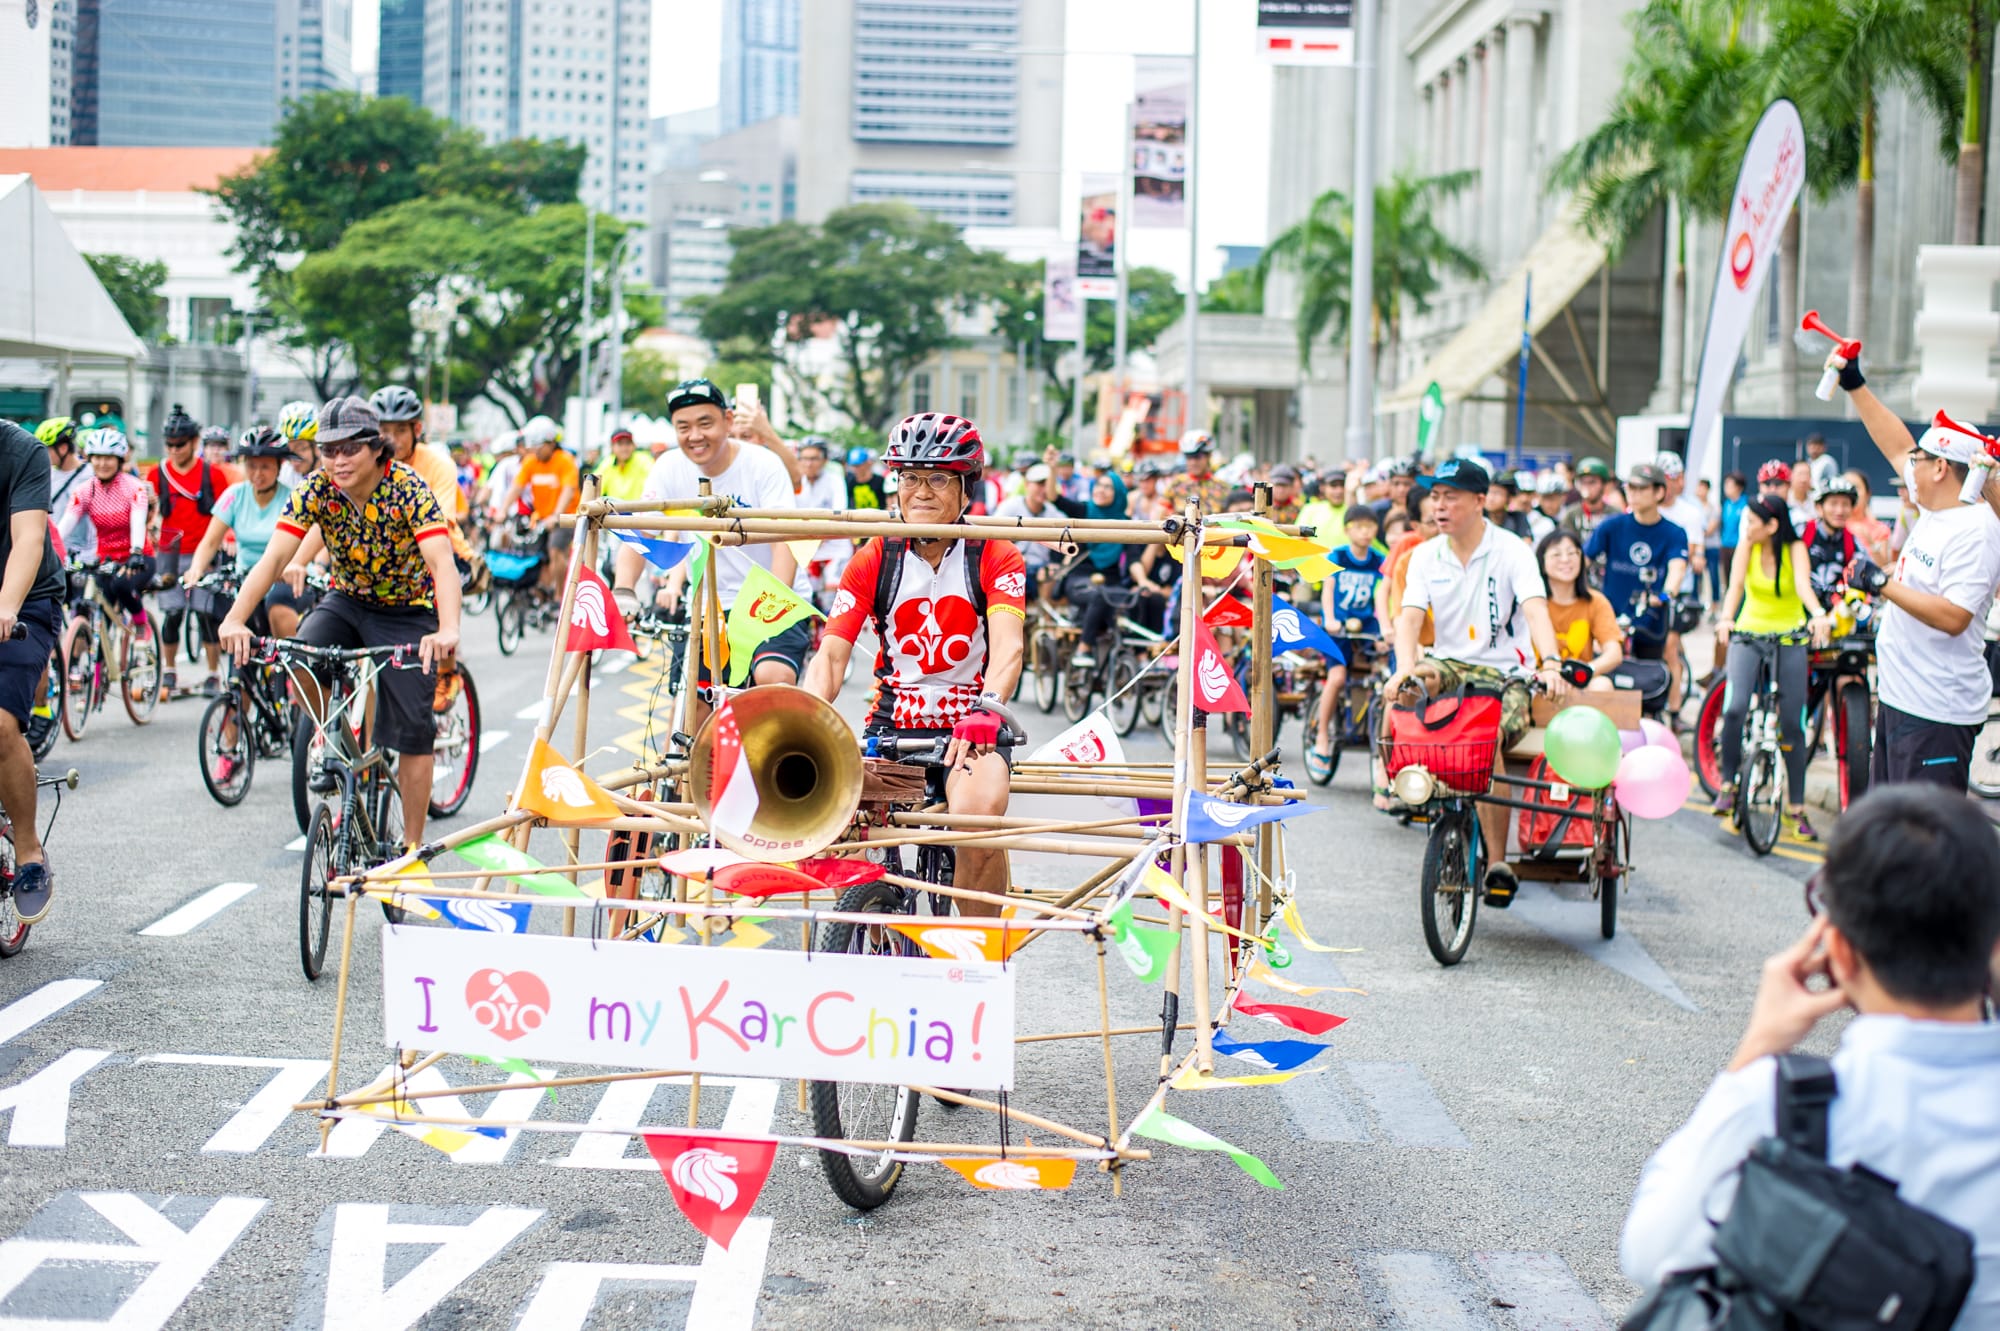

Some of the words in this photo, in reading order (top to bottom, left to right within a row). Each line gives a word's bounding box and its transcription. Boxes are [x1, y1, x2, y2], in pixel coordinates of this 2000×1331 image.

[742, 833, 804, 850] oppee
[414, 976, 439, 1032] I
[588, 997, 662, 1047] my
